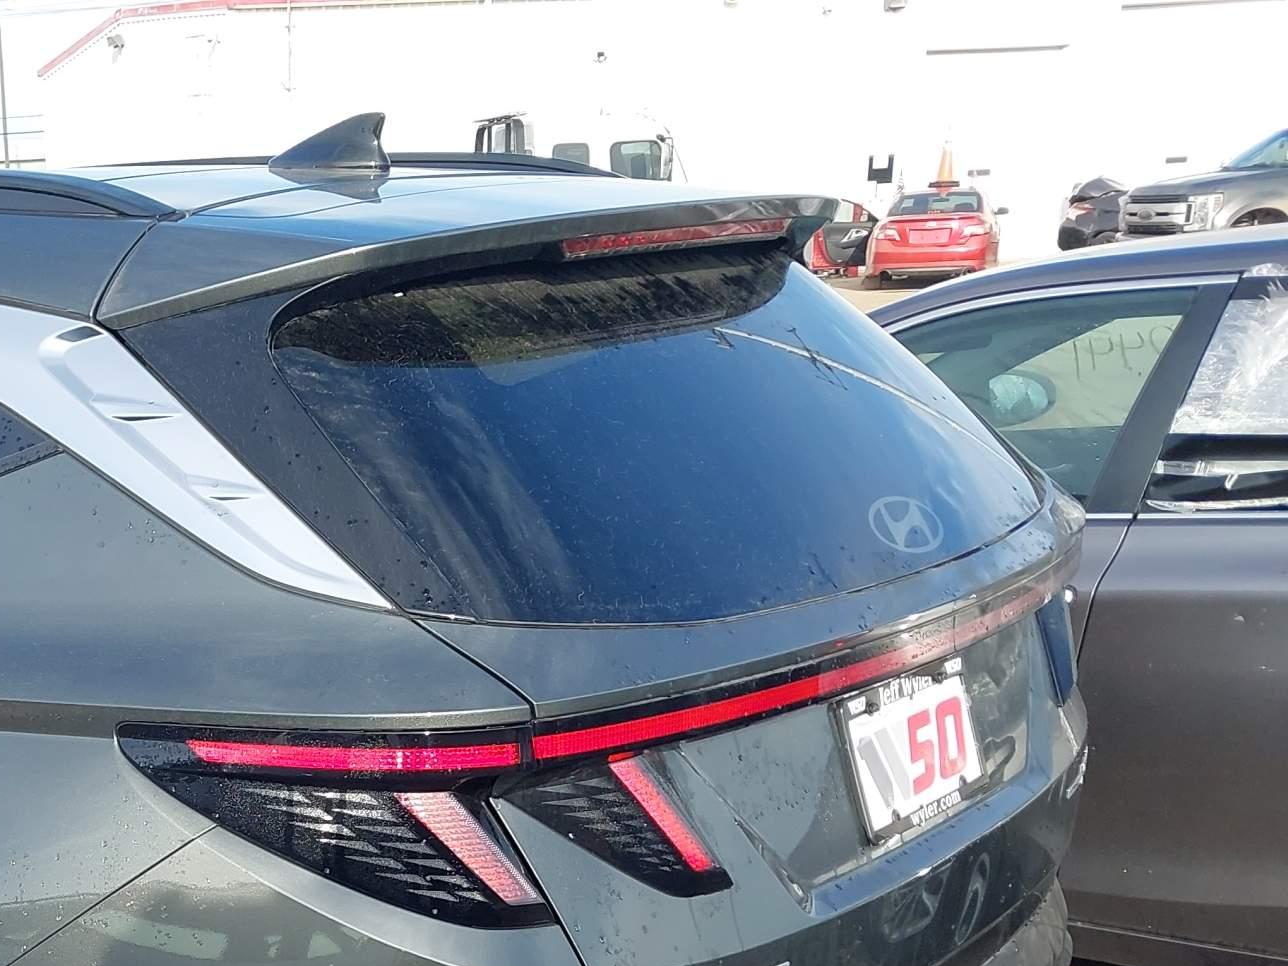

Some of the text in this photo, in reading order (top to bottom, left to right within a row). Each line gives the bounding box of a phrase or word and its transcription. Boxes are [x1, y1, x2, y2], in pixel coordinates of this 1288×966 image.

[879, 675, 934, 706] Jeff Wyler
[911, 790, 962, 828] wyler.com
